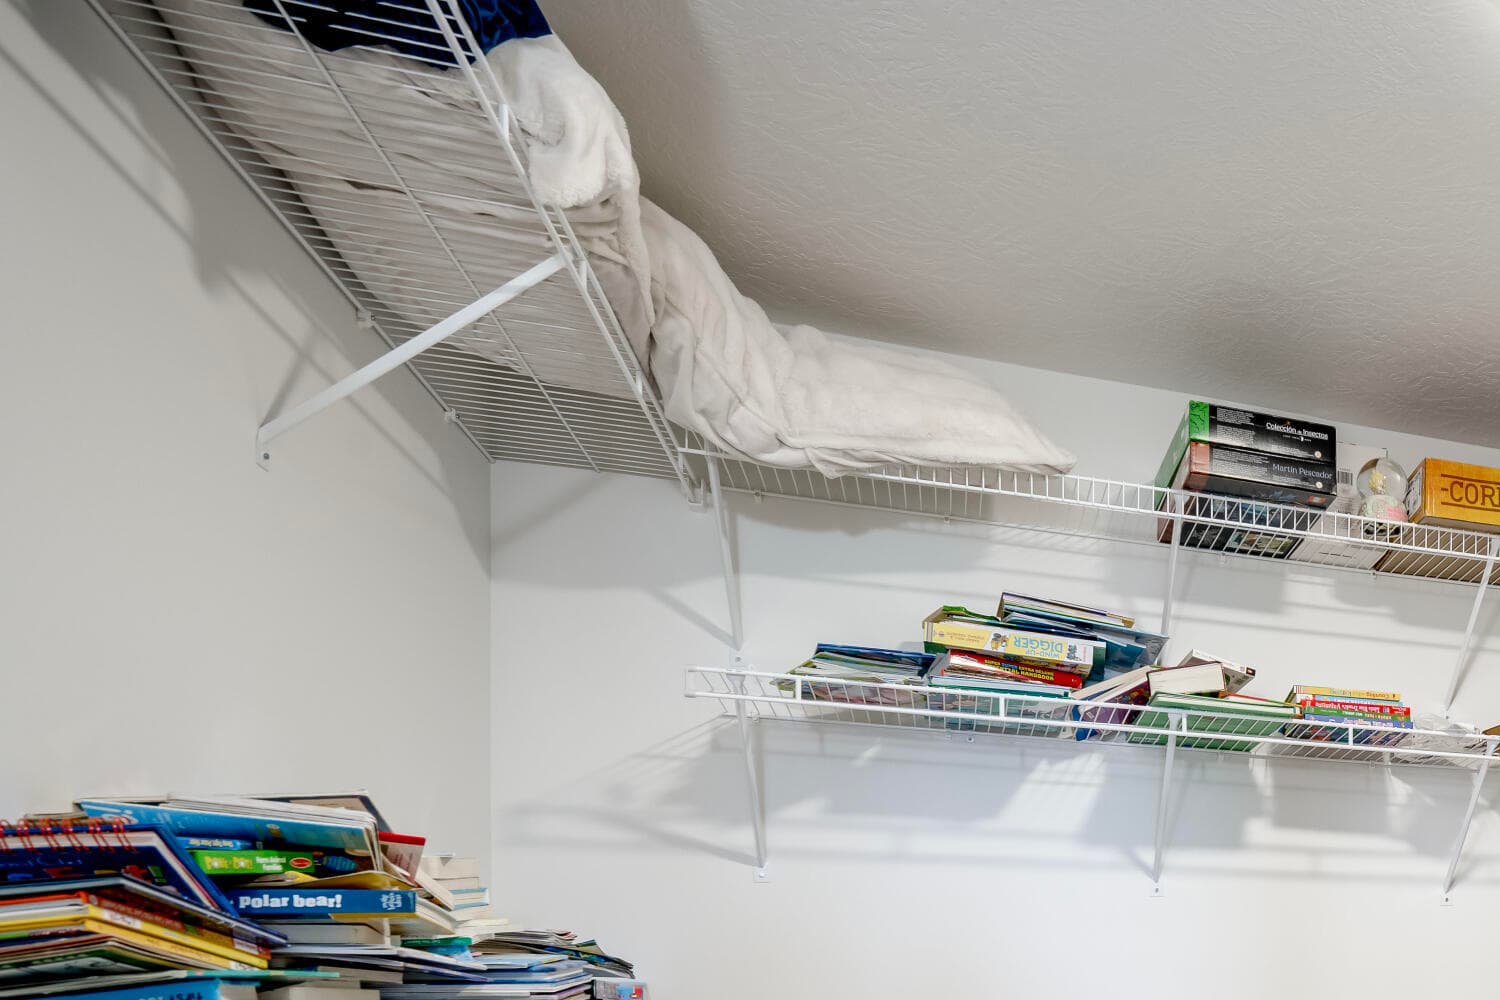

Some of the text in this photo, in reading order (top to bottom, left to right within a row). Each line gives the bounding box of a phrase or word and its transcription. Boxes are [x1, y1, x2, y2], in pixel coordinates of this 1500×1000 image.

[1299, 467, 1334, 481] Pescador
[1014, 636, 1063, 653] DIGGER
[238, 893, 343, 909] Polar bear!
